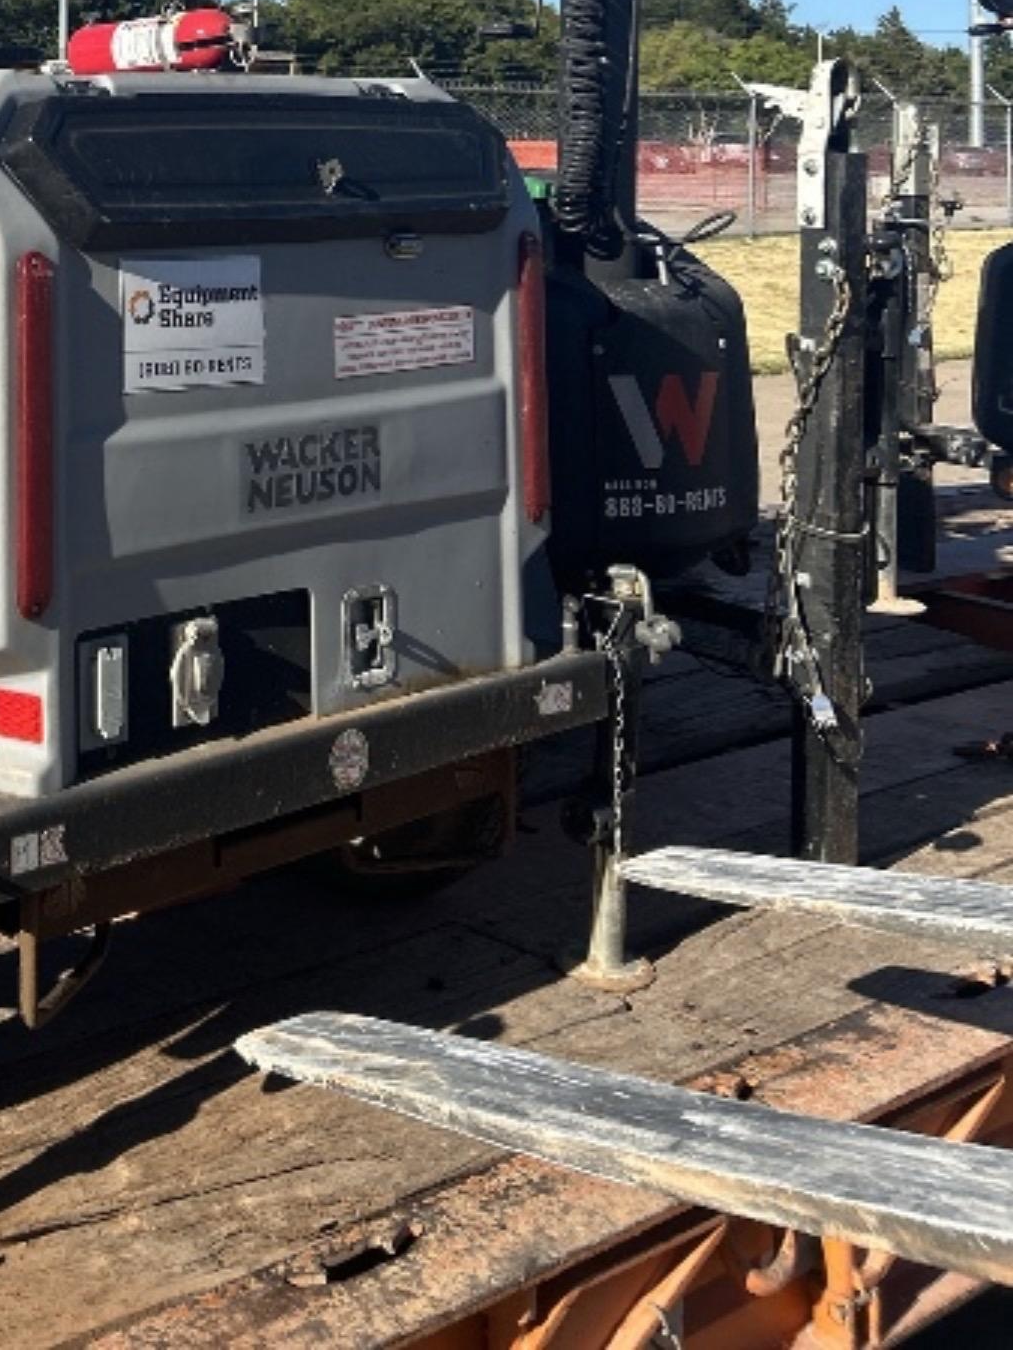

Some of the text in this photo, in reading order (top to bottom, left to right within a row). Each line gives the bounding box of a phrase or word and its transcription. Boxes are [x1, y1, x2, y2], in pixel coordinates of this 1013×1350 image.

[159, 308, 214, 328] Share
[245, 426, 380, 474] WACKER
[247, 460, 381, 514] NEUSON
